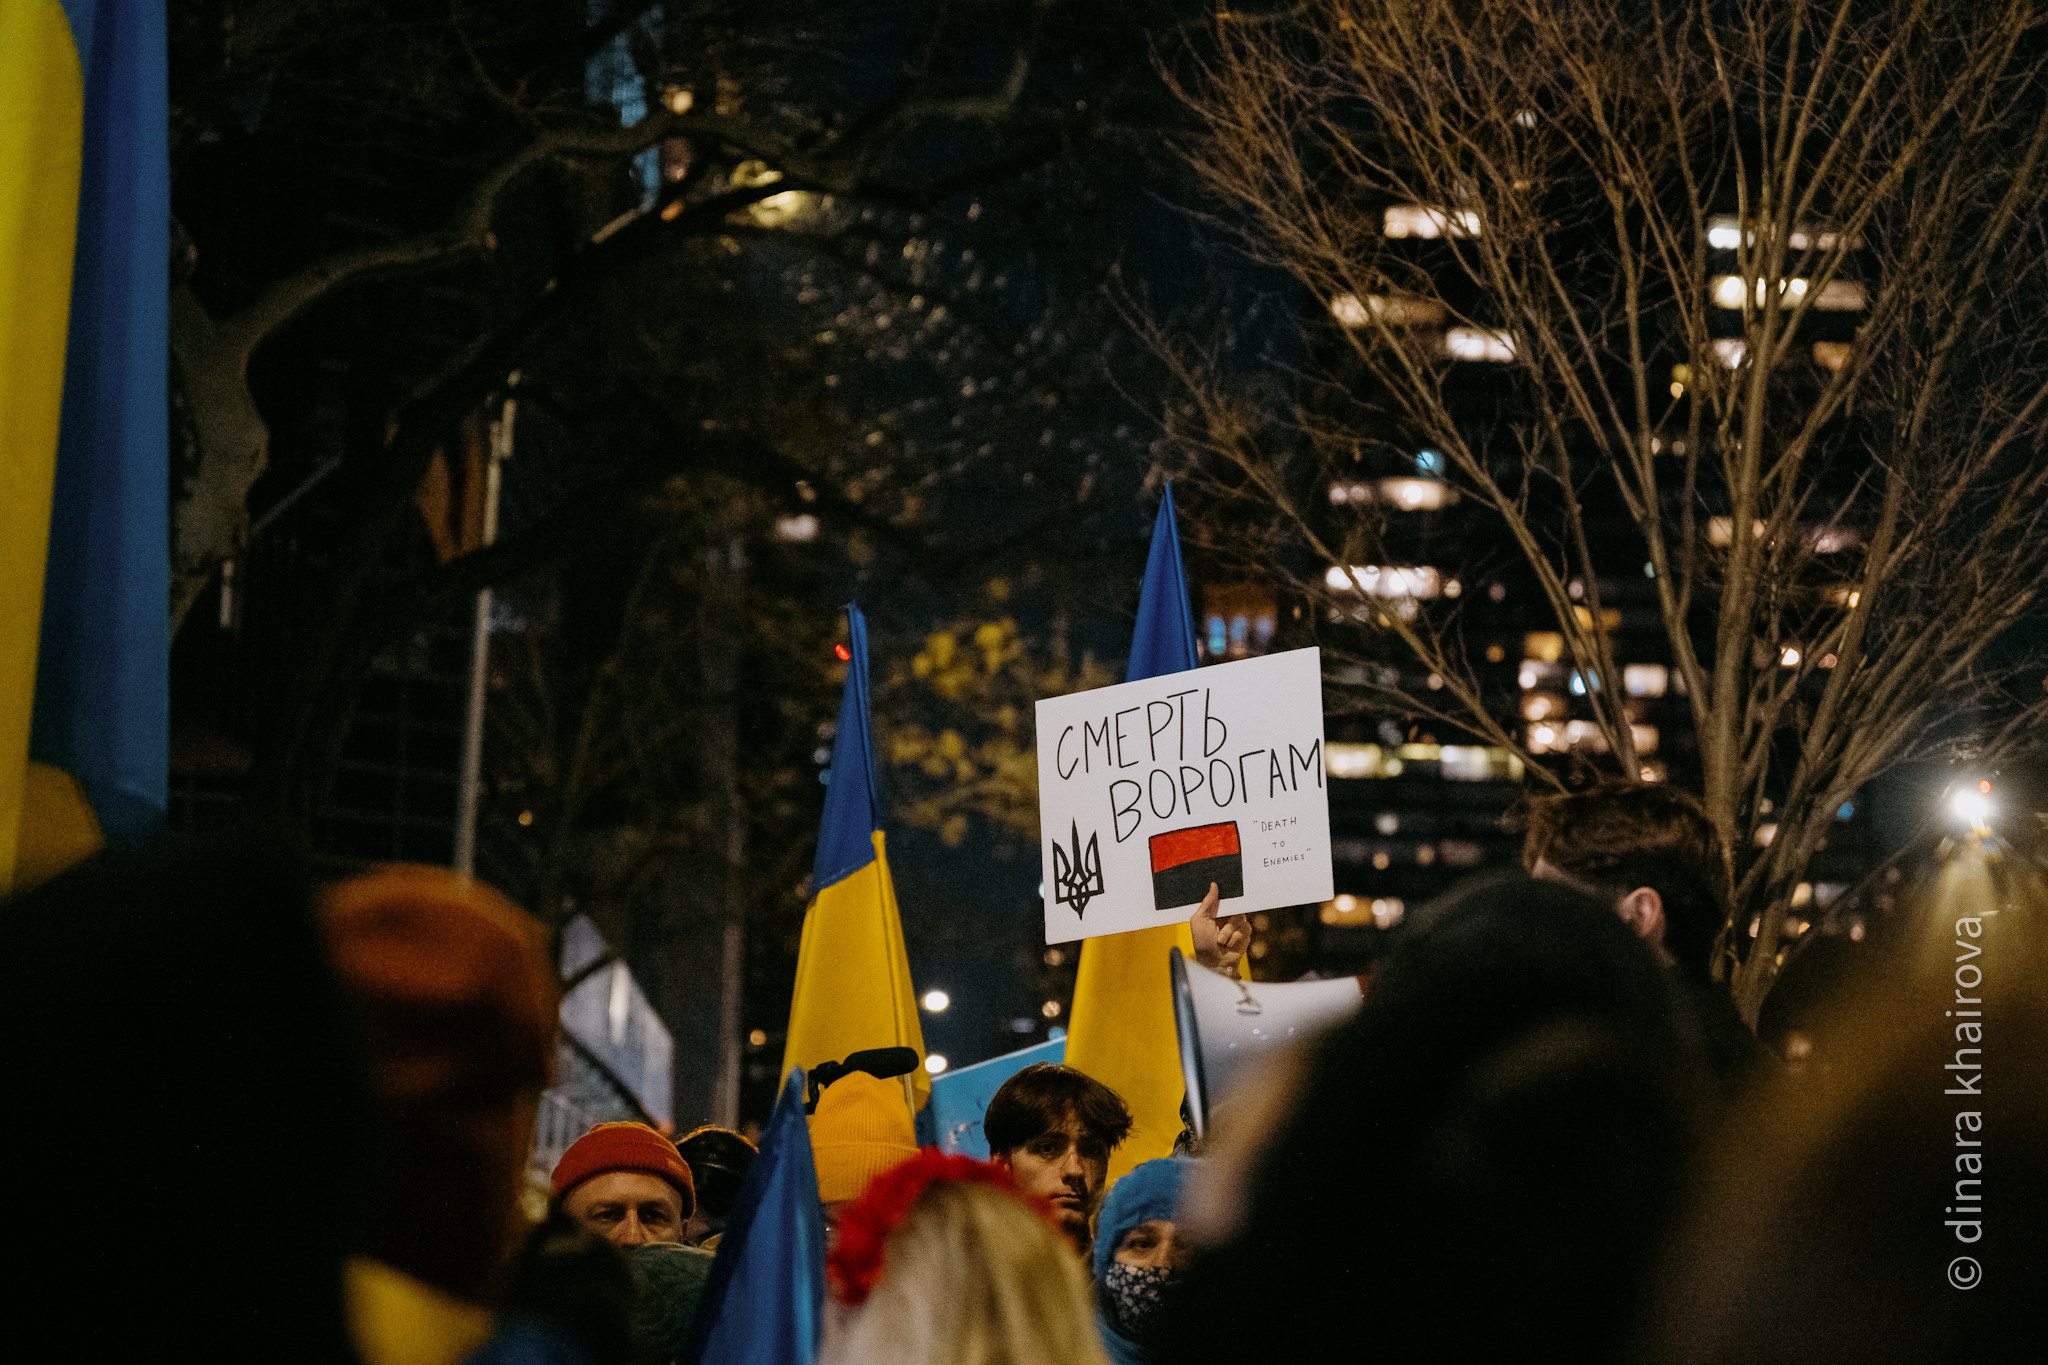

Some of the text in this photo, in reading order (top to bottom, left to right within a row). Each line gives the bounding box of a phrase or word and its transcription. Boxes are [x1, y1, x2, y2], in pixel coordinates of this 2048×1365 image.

[1057, 688, 1227, 780] СМЕРТЬ
[1109, 738, 1322, 843] ВОРОГАМ
[1271, 840, 1286, 849] TO
